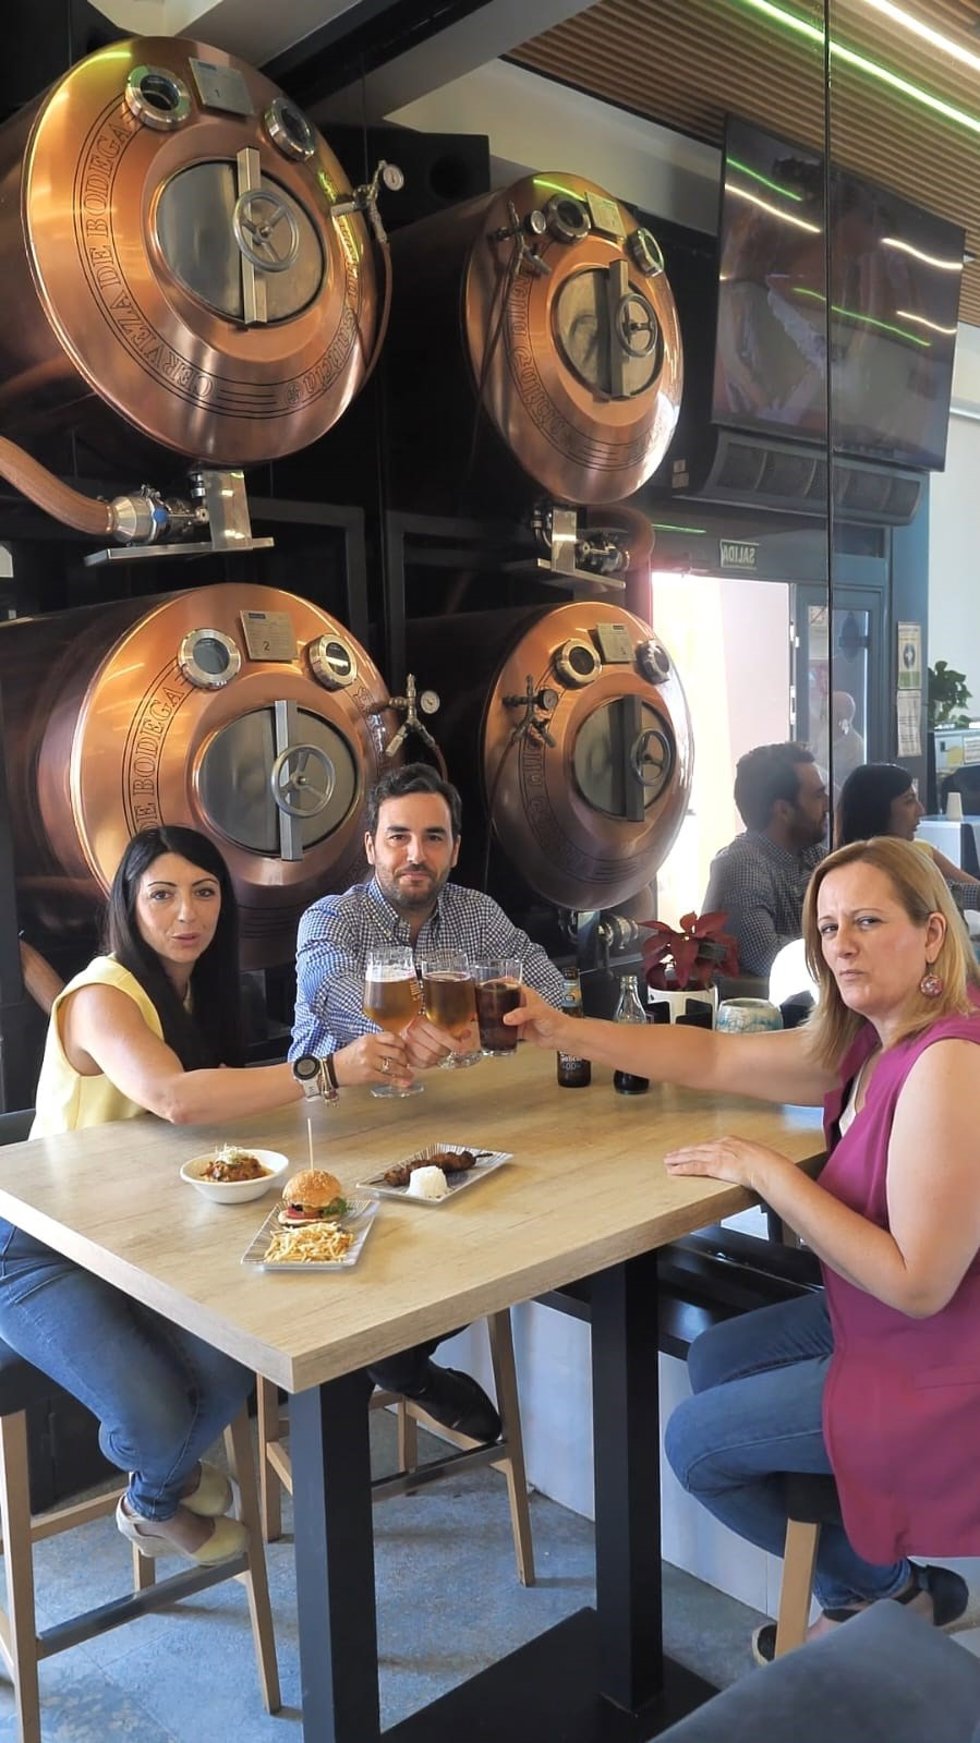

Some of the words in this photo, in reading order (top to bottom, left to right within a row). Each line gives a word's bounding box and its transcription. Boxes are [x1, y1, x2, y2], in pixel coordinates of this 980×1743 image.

[85, 123, 134, 237] BODEGA
[90, 242, 122, 290] DE
[110, 289, 213, 398] CERVEZA
[263, 640, 271, 652] 2
[132, 685, 186, 797] BODEGA
